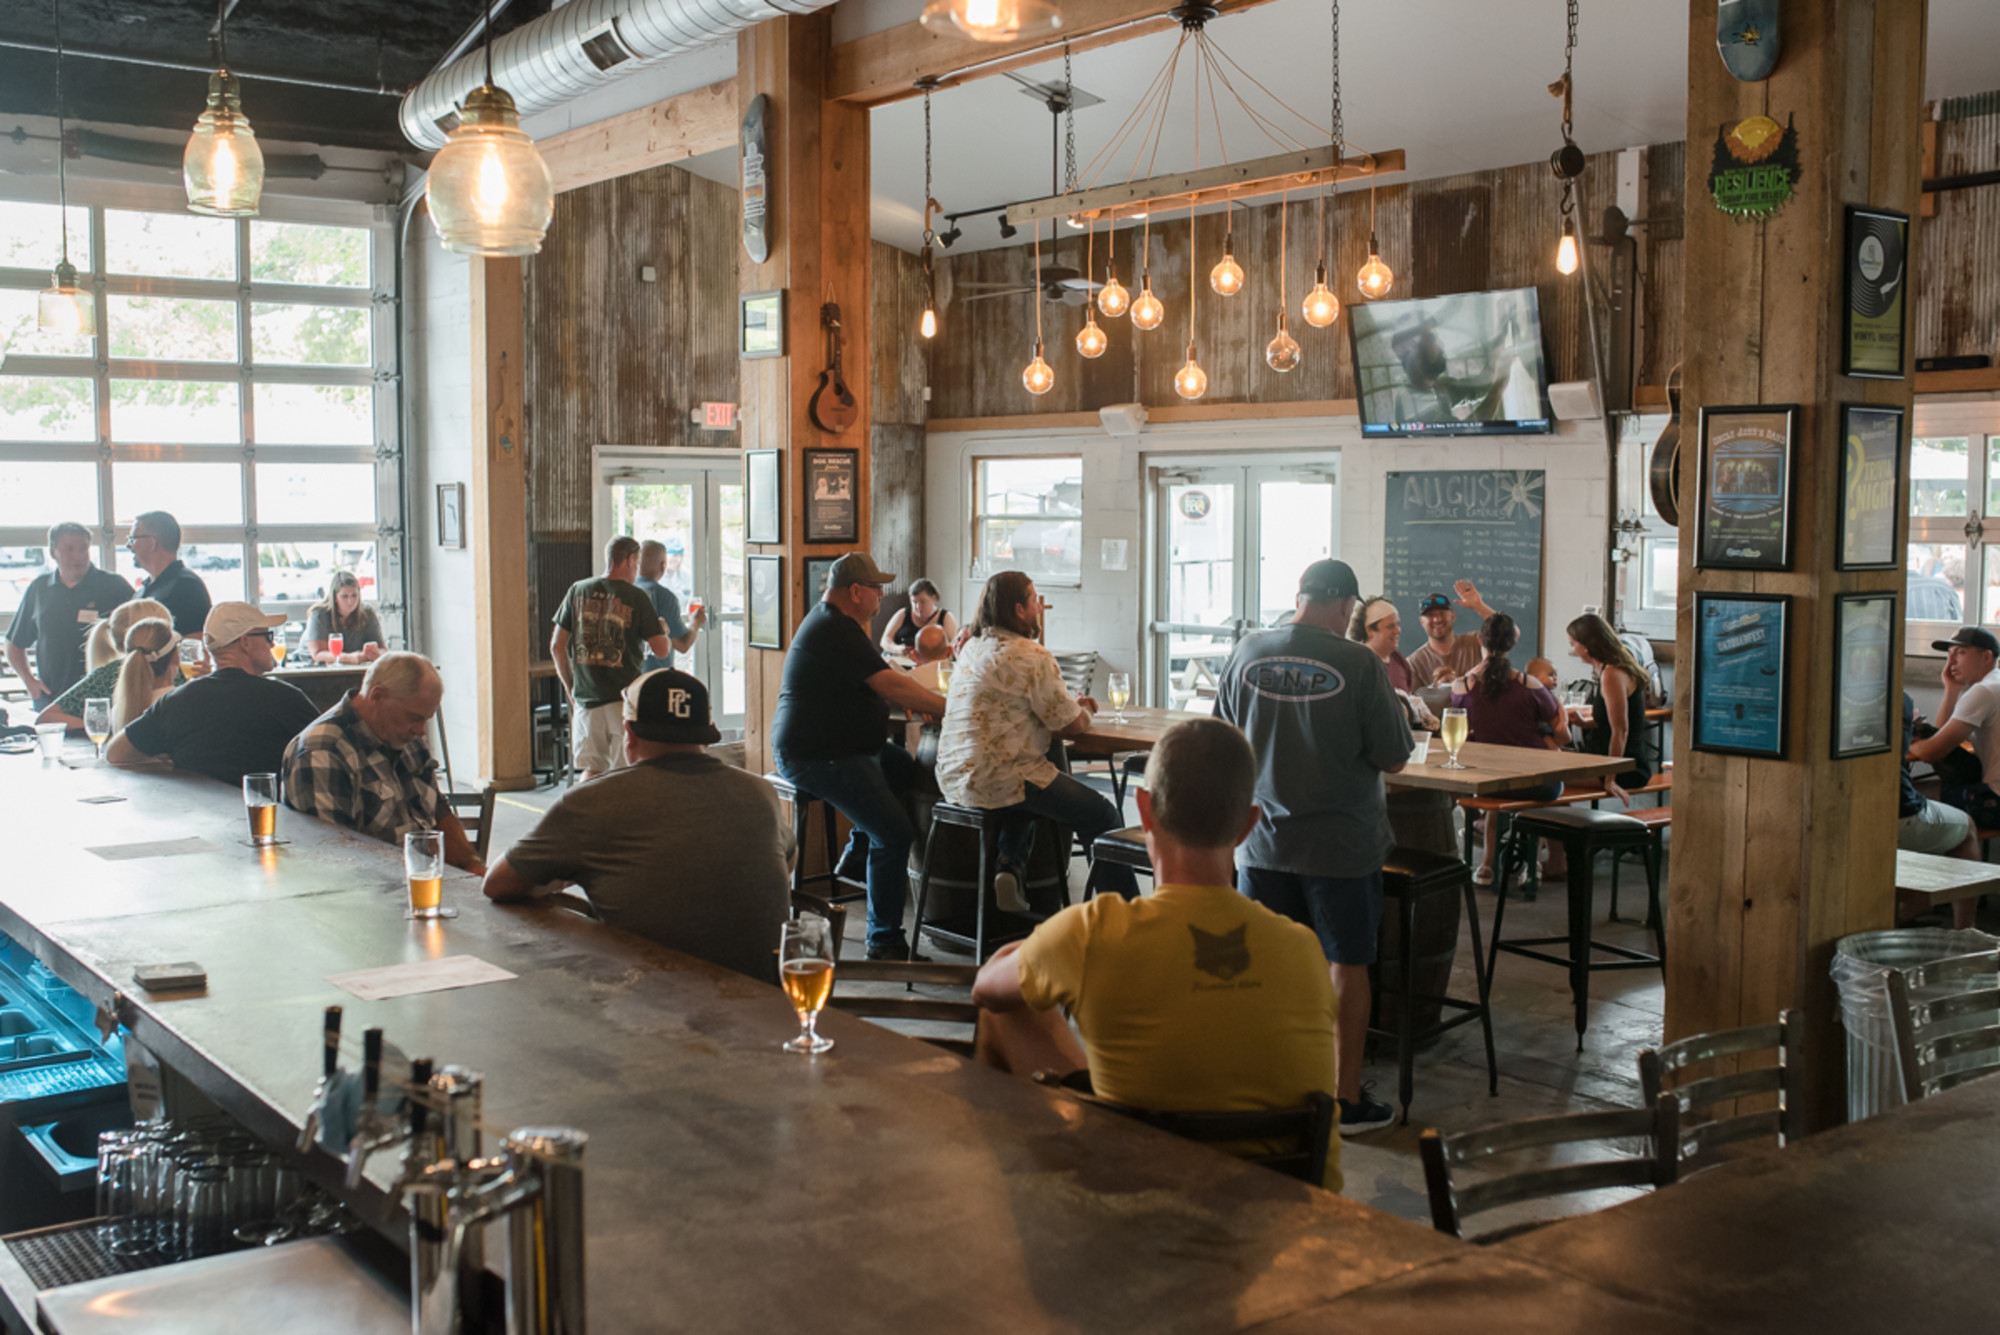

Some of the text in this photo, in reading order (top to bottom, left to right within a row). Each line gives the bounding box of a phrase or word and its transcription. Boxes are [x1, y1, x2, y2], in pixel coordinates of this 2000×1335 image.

[1714, 168, 1791, 194] RESILIENCE
[706, 402, 733, 426] EXIT
[813, 457, 851, 465] DOG RESCUE
[1863, 459, 1893, 481] TRIVIA
[1403, 472, 1512, 510] AUGUST
[1856, 479, 1896, 512] NIGHT
[1259, 667, 1328, 690] GNP
[667, 687, 692, 718] PG
